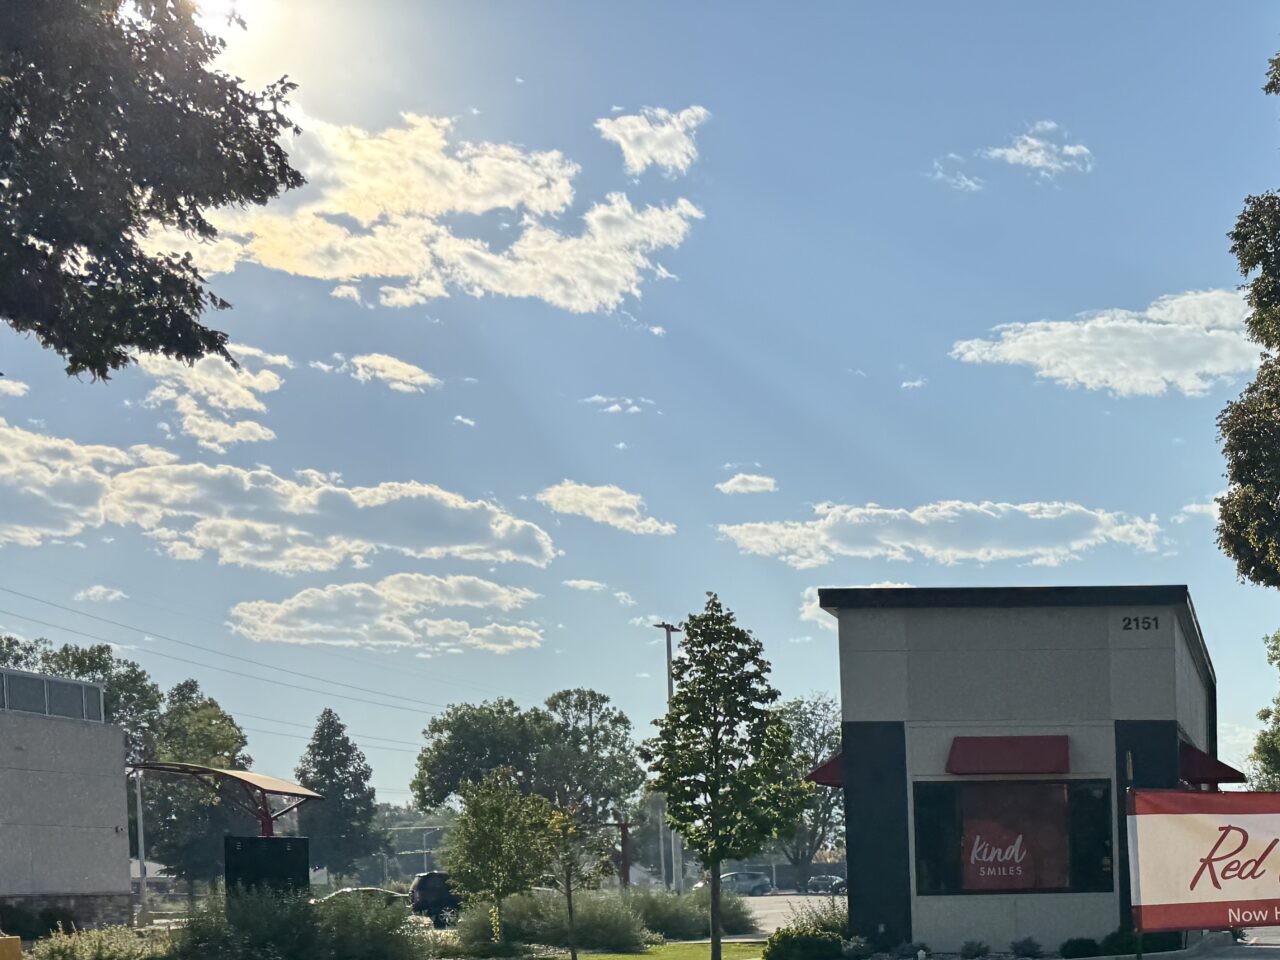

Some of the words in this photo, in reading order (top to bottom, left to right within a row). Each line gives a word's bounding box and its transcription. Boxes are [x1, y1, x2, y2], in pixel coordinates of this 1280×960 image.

[1122, 616, 1159, 630] 2151
[1189, 824, 1279, 891] Red
[979, 866, 1023, 876] SMILES
[1228, 907, 1268, 923] Now
